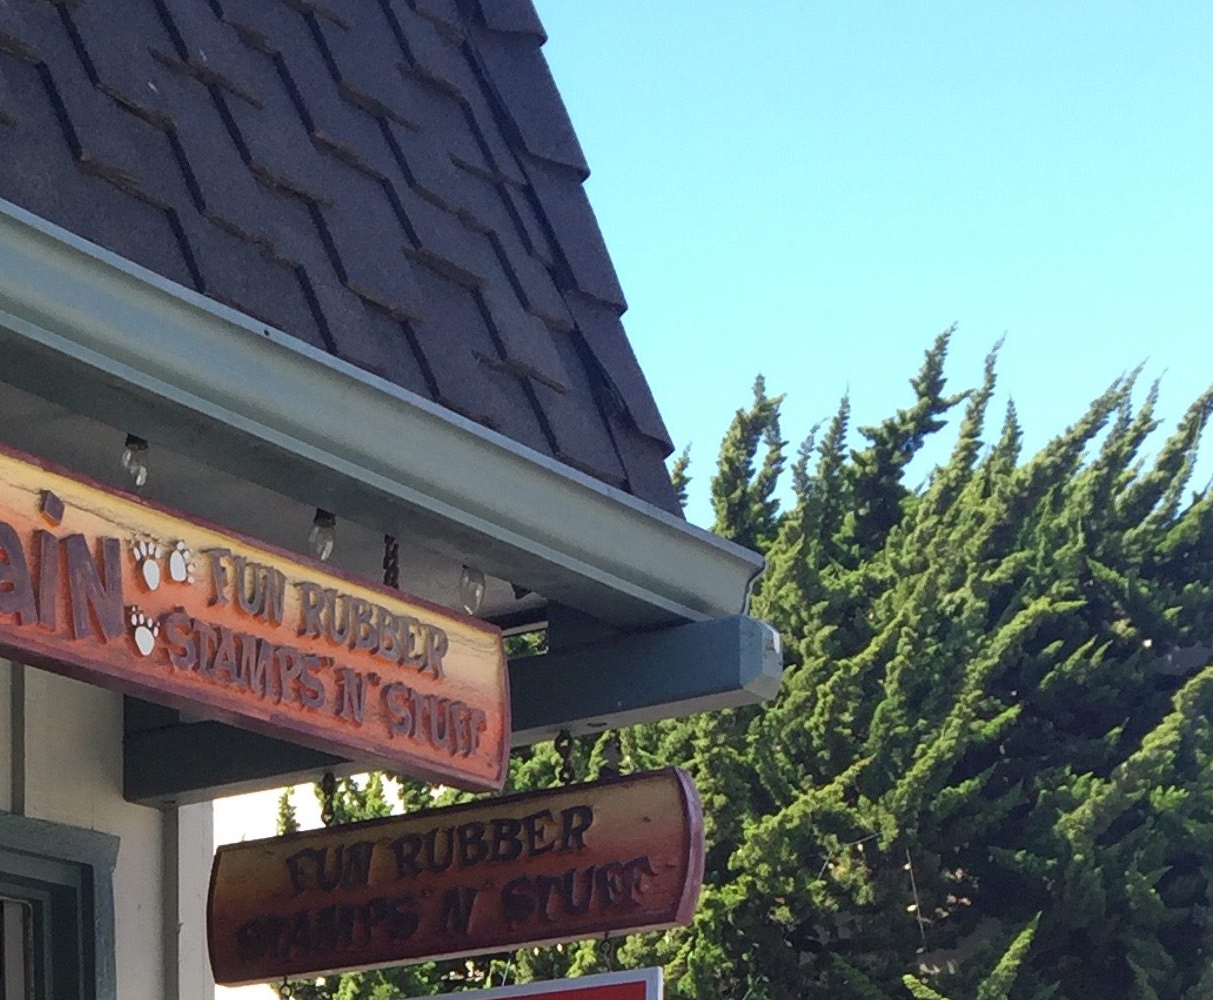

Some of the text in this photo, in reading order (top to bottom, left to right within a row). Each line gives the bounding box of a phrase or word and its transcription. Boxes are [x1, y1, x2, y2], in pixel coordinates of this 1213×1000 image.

[200, 548, 449, 679] FUN RUBBER
[164, 609, 327, 710] STAMPS
[381, 681, 487, 757] STUFF
[287, 804, 594, 894] FUN RUBBER
[501, 855, 657, 924] STUFF
